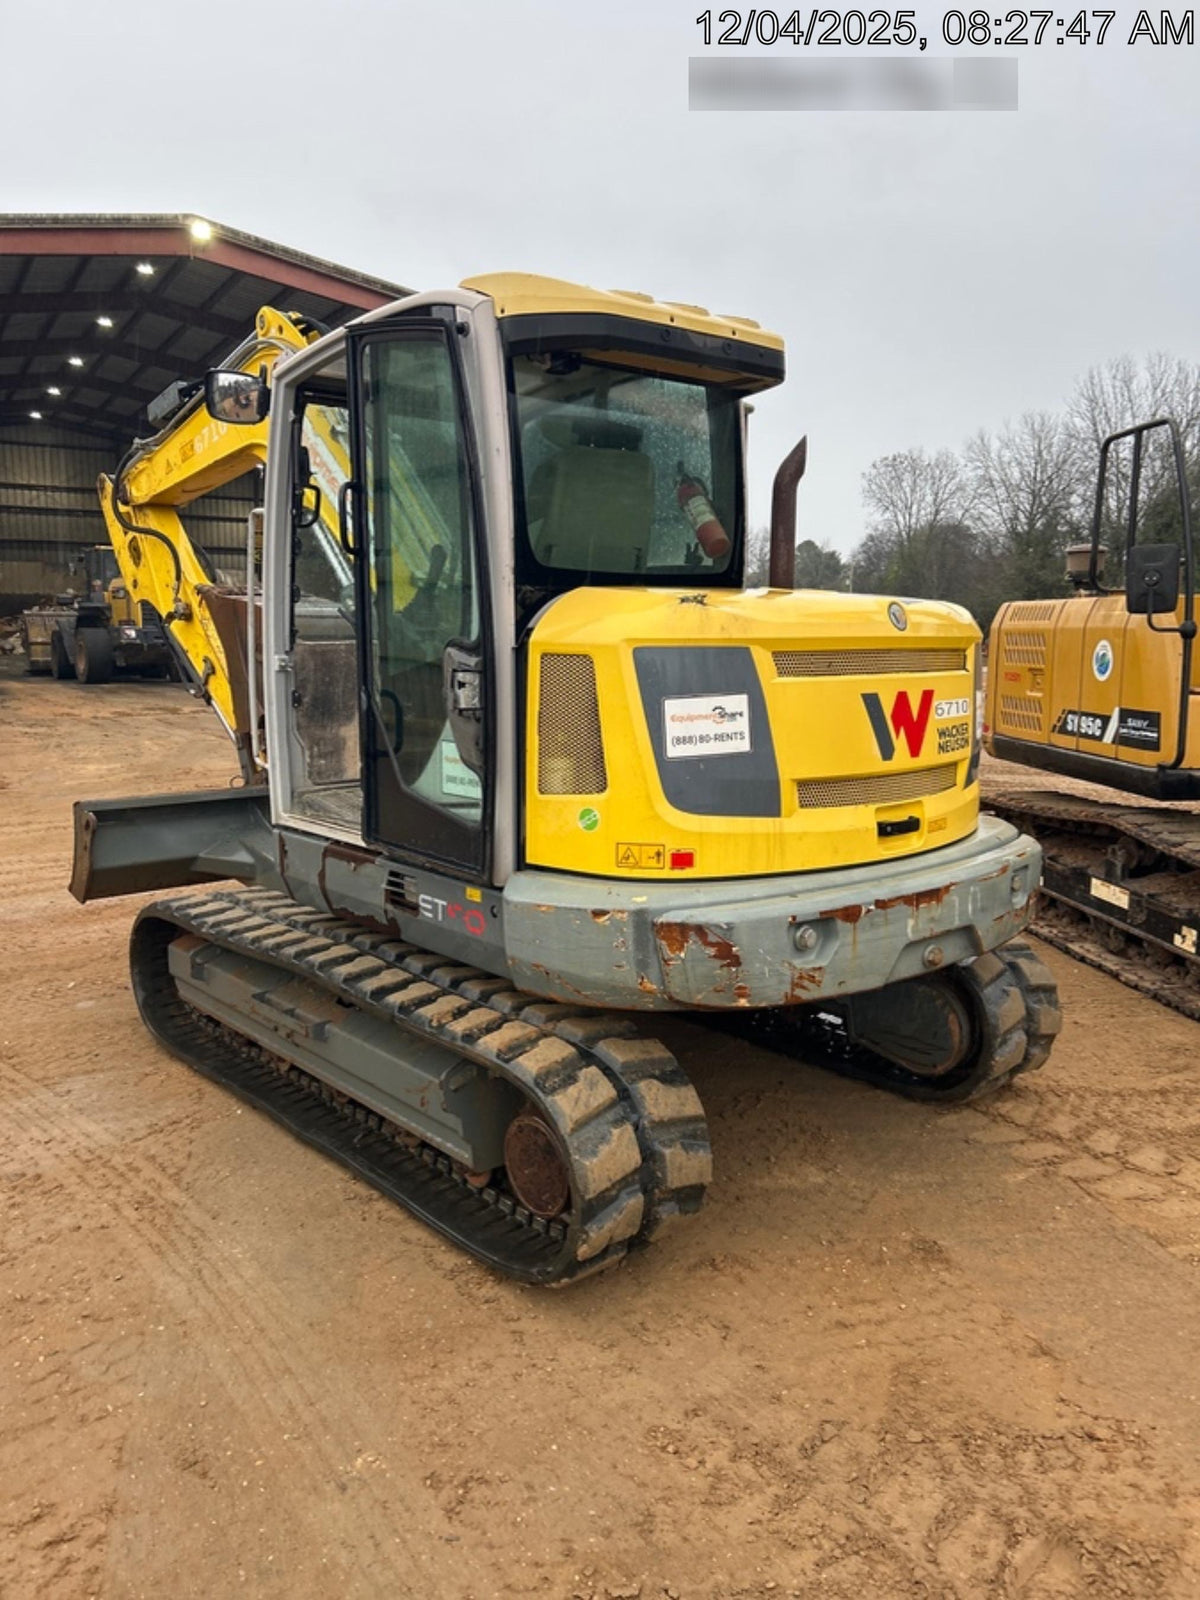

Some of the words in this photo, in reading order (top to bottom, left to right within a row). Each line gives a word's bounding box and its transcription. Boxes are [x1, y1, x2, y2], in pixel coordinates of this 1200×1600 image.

[935, 699, 969, 718] 6710
[936, 722, 970, 740] WACKER
[937, 738, 970, 755] NEUSON
